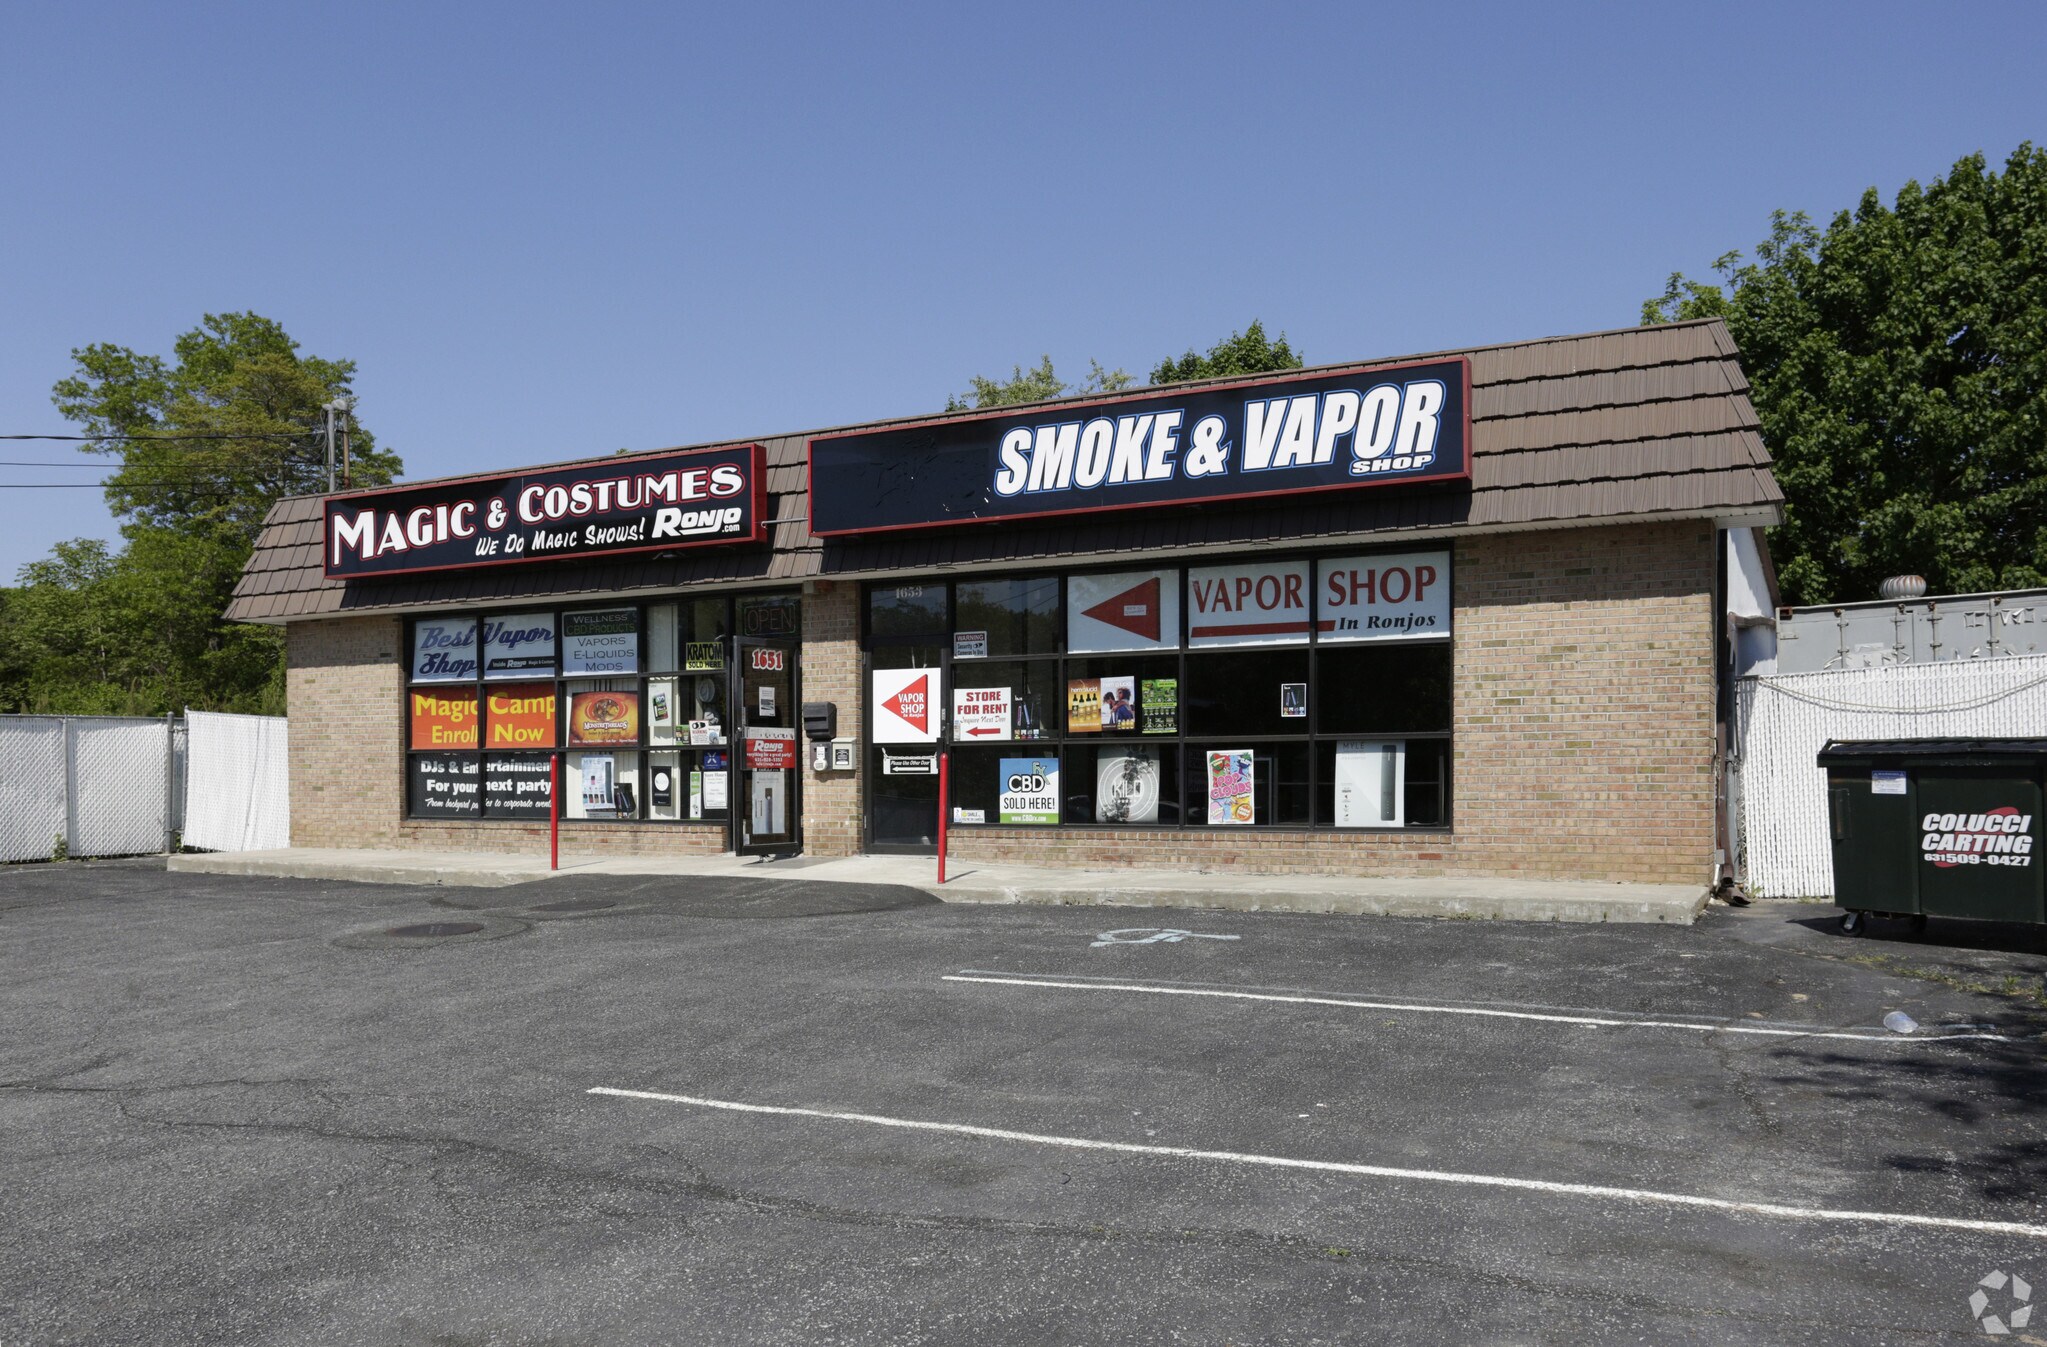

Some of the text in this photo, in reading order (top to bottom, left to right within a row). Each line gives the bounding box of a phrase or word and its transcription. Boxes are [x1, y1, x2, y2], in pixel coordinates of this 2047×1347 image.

[996, 381, 1446, 495] SMOKE & VAPOR
[1351, 453, 1434, 474] SHOP
[332, 466, 743, 566] MAGIC & COSTUMES
[531, 530, 578, 551] MAGIC
[584, 517, 645, 545] SHOWS!
[721, 522, 740, 533] .com
[895, 585, 923, 599] 1653
[1192, 565, 1436, 613] VAPOR SHOP
[573, 614, 628, 624] WELLNESS
[747, 606, 793, 632] OPEN
[1339, 612, 1436, 634] In Ronjos
[421, 622, 555, 648] Best Vapor
[567, 623, 635, 635] CBD PRODUCTS
[577, 636, 626, 647] VAPORS
[957, 634, 984, 642] WARNING
[574, 649, 635, 660] E-LIQUIDS
[687, 643, 722, 660] KRATOM
[753, 650, 783, 670] 1651
[419, 652, 477, 678] Shop
[585, 662, 624, 672] MODS
[898, 693, 924, 703] VAPOR
[966, 691, 1002, 702] STORE
[415, 692, 555, 723] Magic Camp
[901, 704, 924, 714] SHOP
[957, 705, 980, 715] FOR
[982, 703, 1008, 714] RENT
[494, 724, 545, 743] Now
[421, 761, 445, 773] DJs
[449, 761, 460, 774] &
[426, 779, 449, 792] For
[453, 782, 478, 795] your
[517, 779, 552, 795] party
[1008, 774, 1045, 793] CBD
[1217, 772, 1240, 787] POP
[1210, 782, 1252, 800] CLOUDS
[1004, 797, 1055, 809] SOLD HERE!
[1922, 813, 2031, 833] COLUCCI
[1921, 833, 2033, 854] CARTING
